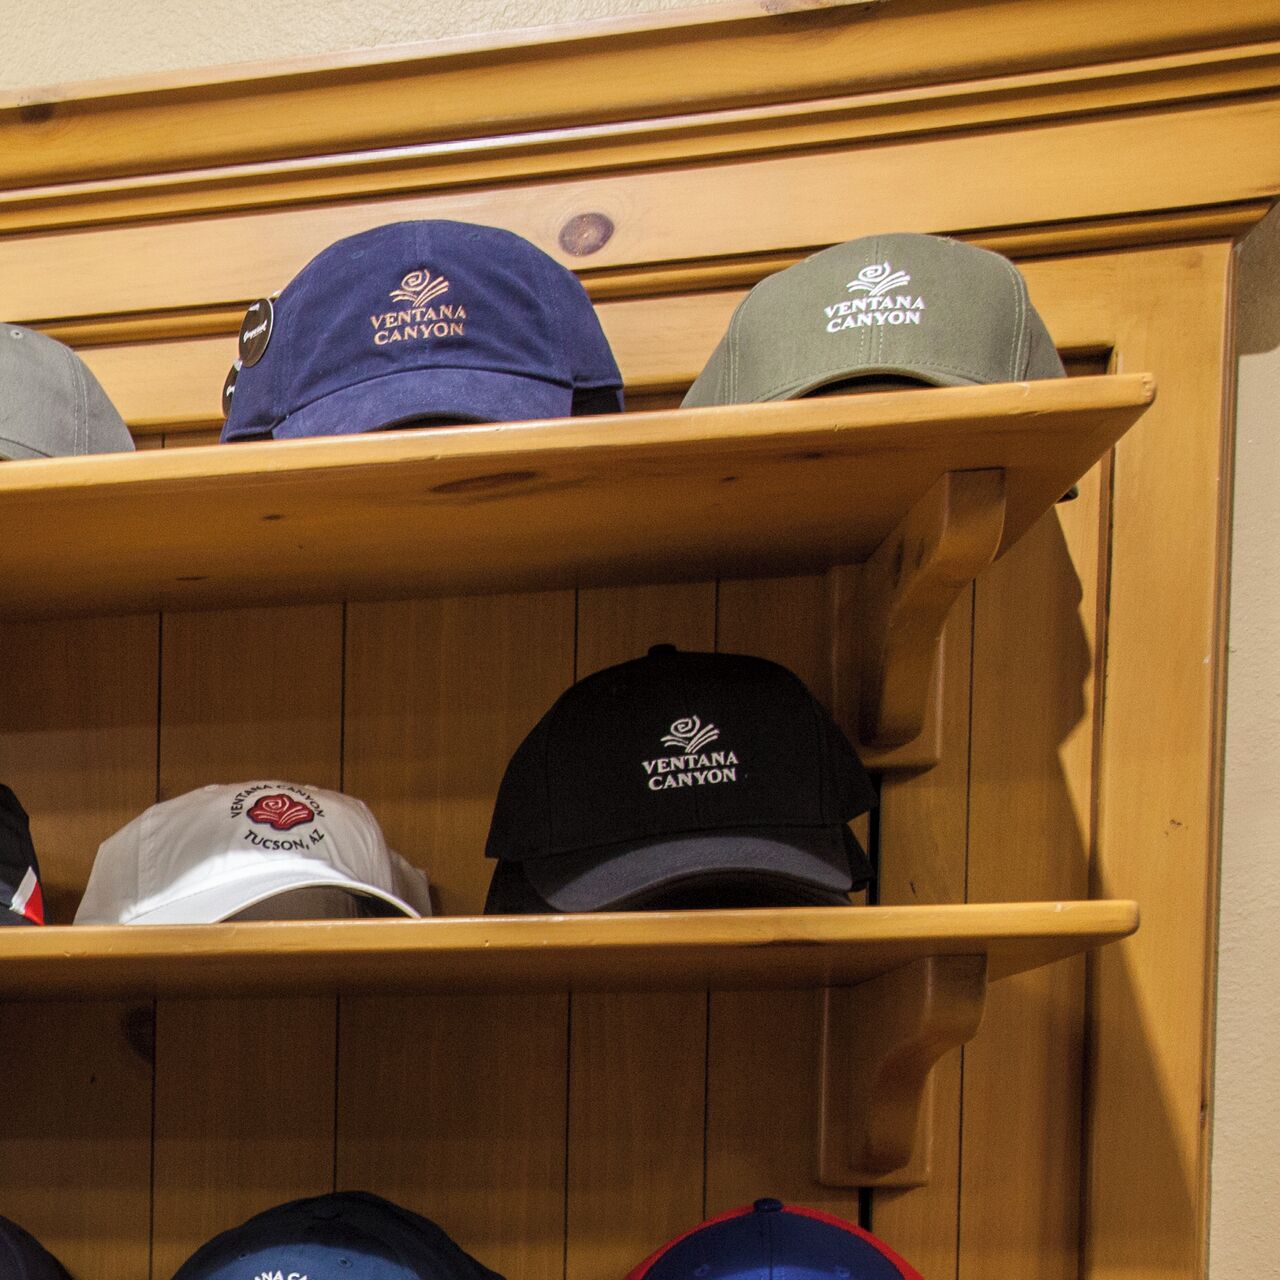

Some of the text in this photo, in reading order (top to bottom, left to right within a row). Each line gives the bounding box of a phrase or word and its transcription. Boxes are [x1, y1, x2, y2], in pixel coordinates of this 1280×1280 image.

[370, 304, 468, 329] VENTANA
[824, 295, 926, 319] VENTANA
[374, 321, 465, 346] CANYON
[826, 311, 921, 333] CANYON
[641, 751, 739, 775] VENTANA
[648, 767, 737, 791] CANYON
[231, 783, 325, 819] VENTANA CANYON
[243, 828, 325, 851] TUCSON, AZ
